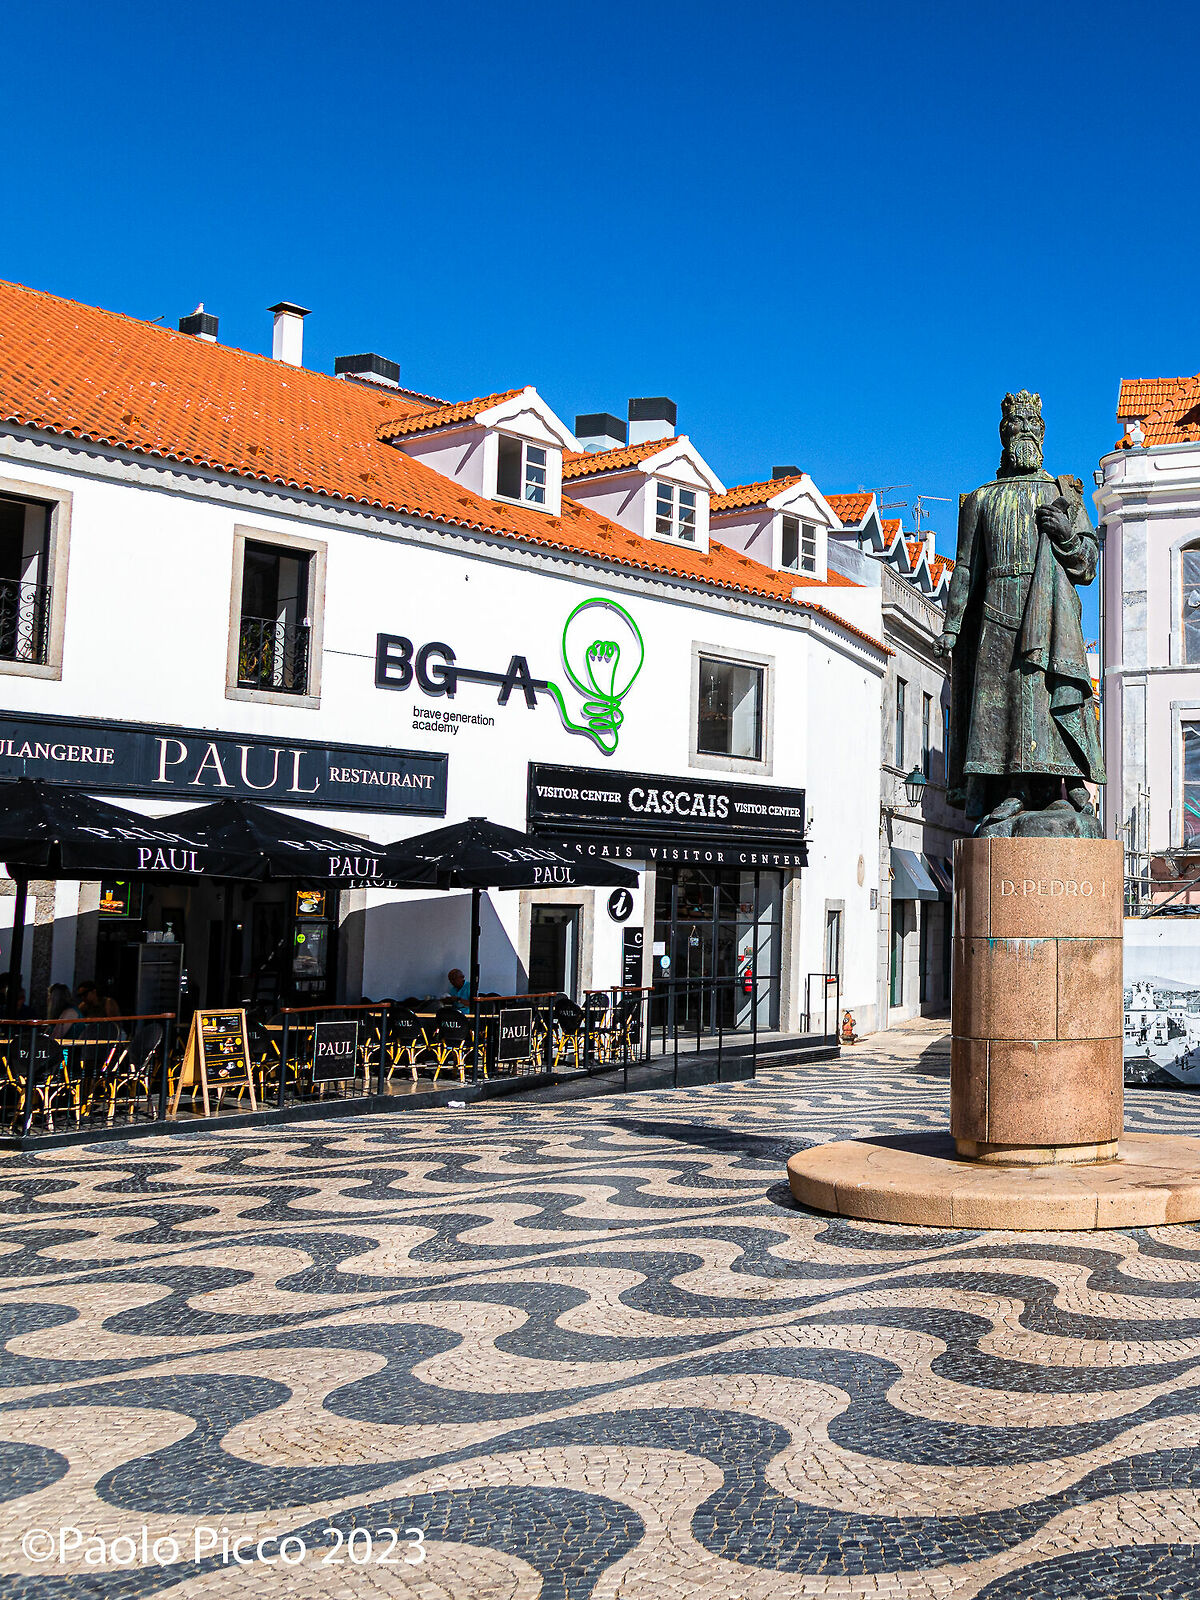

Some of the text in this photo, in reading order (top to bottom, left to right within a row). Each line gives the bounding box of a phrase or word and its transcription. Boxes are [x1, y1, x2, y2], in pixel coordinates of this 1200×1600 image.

[413, 706, 495, 727] brave generation
[412, 719, 459, 735] academy
[152, 737, 321, 794] PAUL
[328, 766, 435, 789] RESTAURANT
[536, 785, 801, 819] VISITOR CENTER CASCAIS VISITOR CENTER
[77, 827, 208, 847] PAUL
[137, 847, 205, 873] PAUL
[492, 847, 576, 863] PAUL
[575, 844, 801, 865] SCAIS VISITOR CENTER
[328, 857, 383, 878] PAUL
[533, 867, 576, 884] PAUL
[1023, 879, 1094, 897] PEDRO
[502, 1025, 529, 1039] PAUL
[317, 1041, 354, 1056] PAUL
